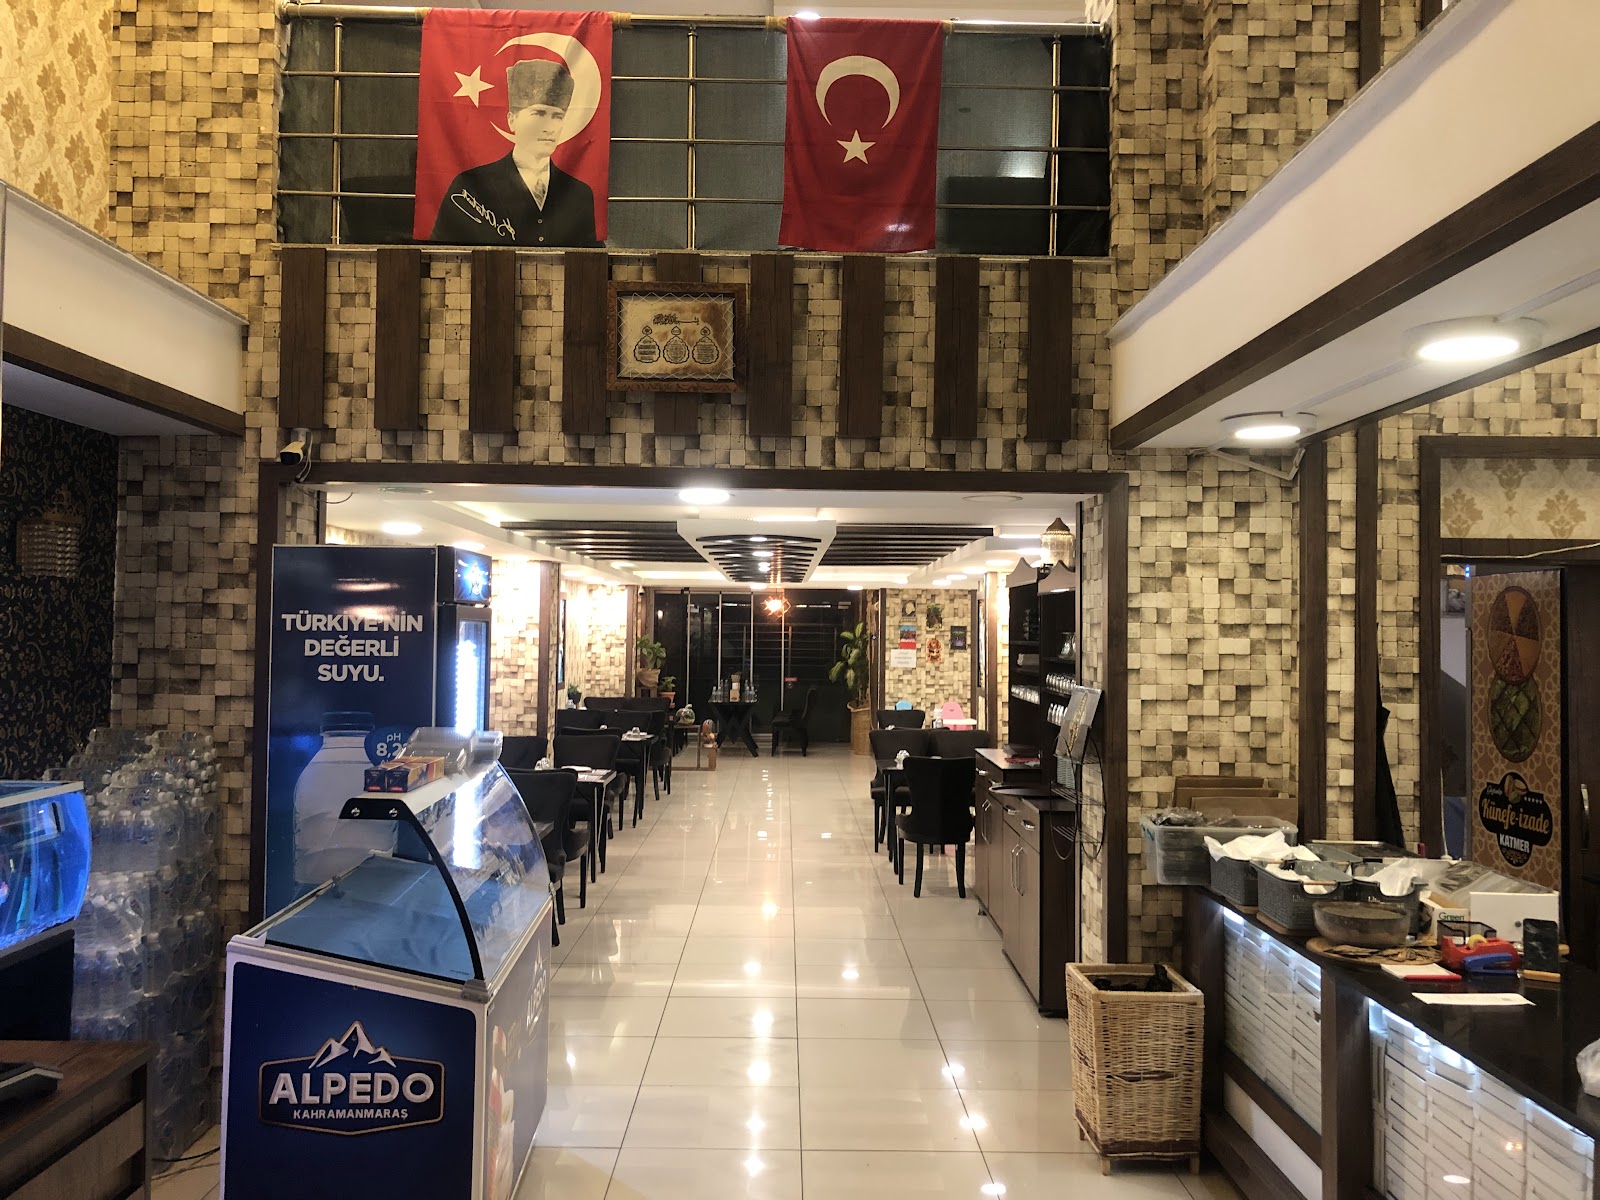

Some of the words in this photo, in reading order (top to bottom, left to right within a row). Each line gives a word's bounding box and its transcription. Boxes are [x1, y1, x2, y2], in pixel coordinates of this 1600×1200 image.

[281, 610, 424, 632] TÜRKİYE'NİN
[304, 634, 399, 656] DEĞERLİ
[317, 664, 385, 682] SUYU.
[386, 732, 402, 743] pH
[1481, 798, 1550, 834] Künefe-izade
[1499, 833, 1530, 853] KATMER
[1438, 912, 1465, 922] Green
[268, 1072, 435, 1105] ALPEDO
[293, 1108, 409, 1120] KAHRAMANMARAŞ
